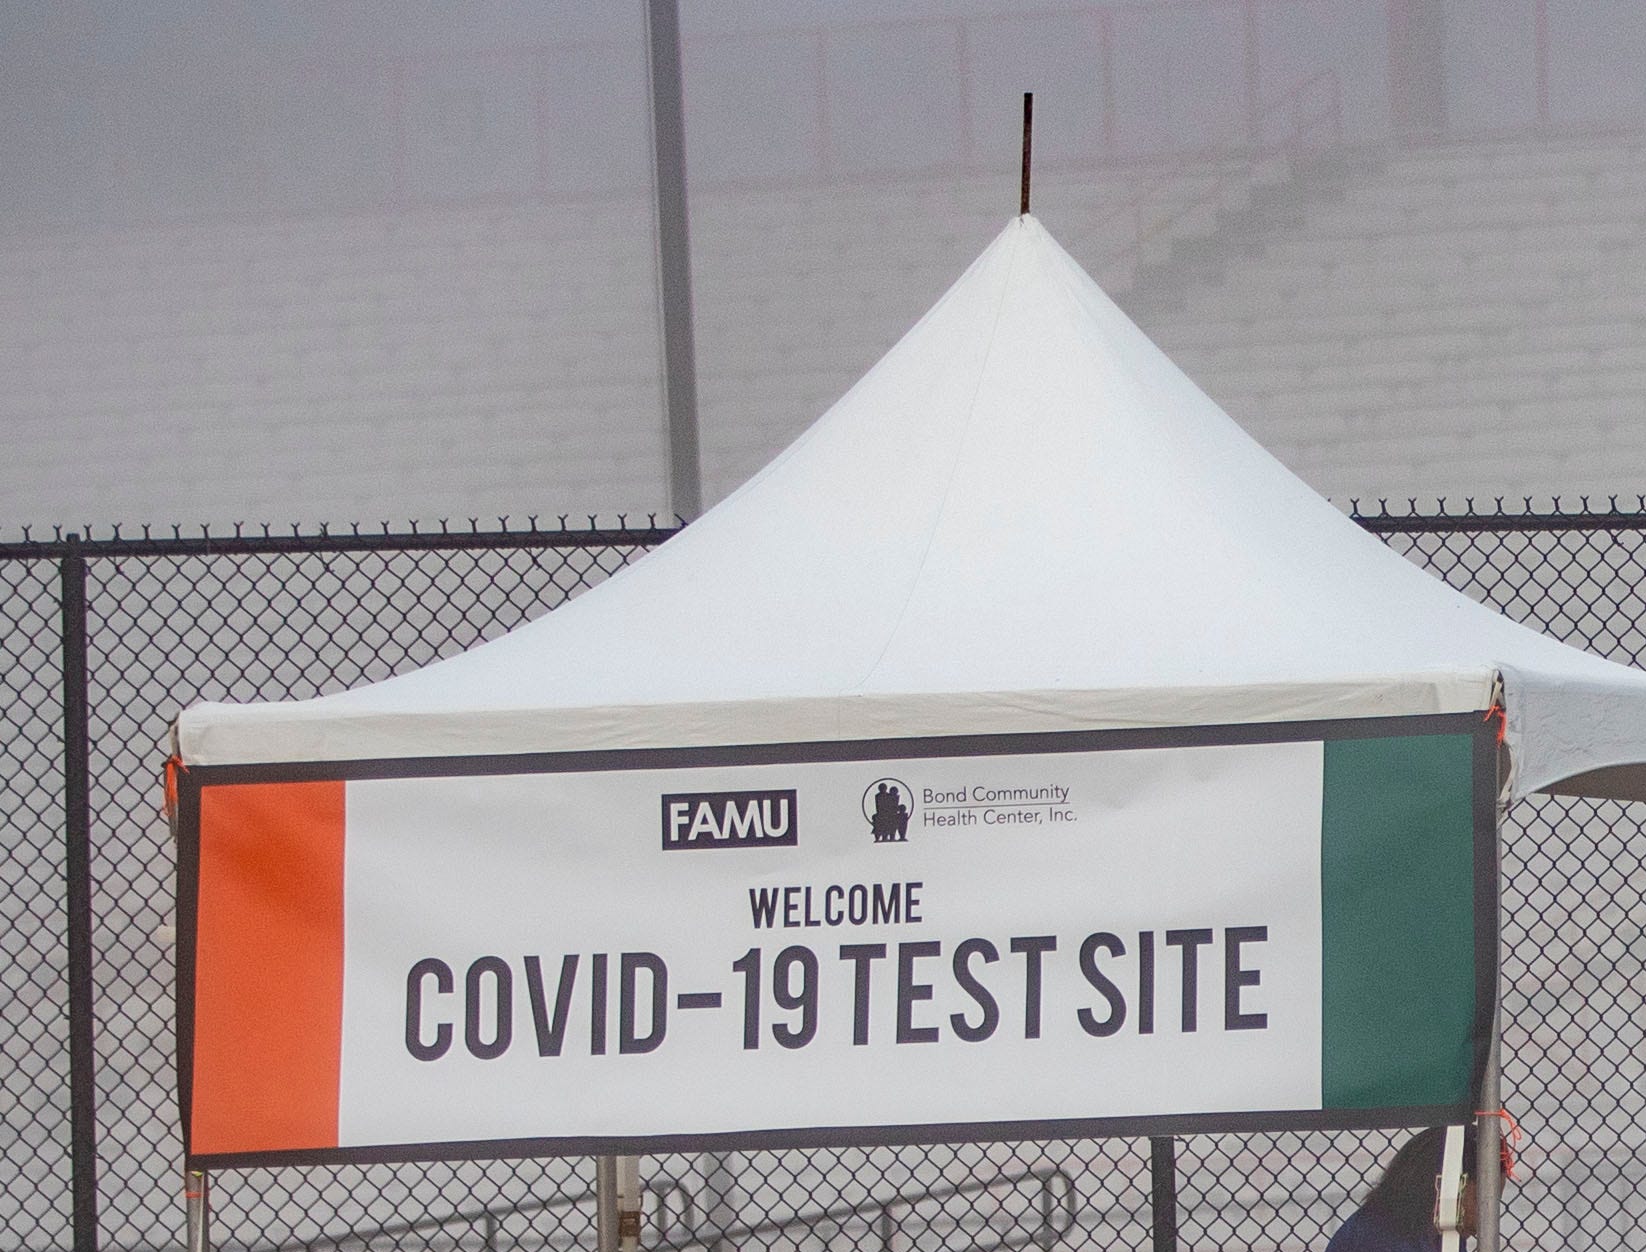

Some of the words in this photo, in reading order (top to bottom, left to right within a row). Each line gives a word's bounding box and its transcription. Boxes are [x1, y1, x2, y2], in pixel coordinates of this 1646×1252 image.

[923, 786, 967, 804] Bond
[972, 784, 1070, 803] Community
[669, 799, 790, 841] FAMU
[923, 810, 977, 828] Health
[983, 809, 1043, 825] Center,
[1049, 807, 1078, 823] Inc.
[750, 882, 923, 928] WELCOME
[404, 944, 819, 1062] COVID-19
[838, 935, 1057, 1046] TEST
[1076, 925, 1269, 1038] SITE
